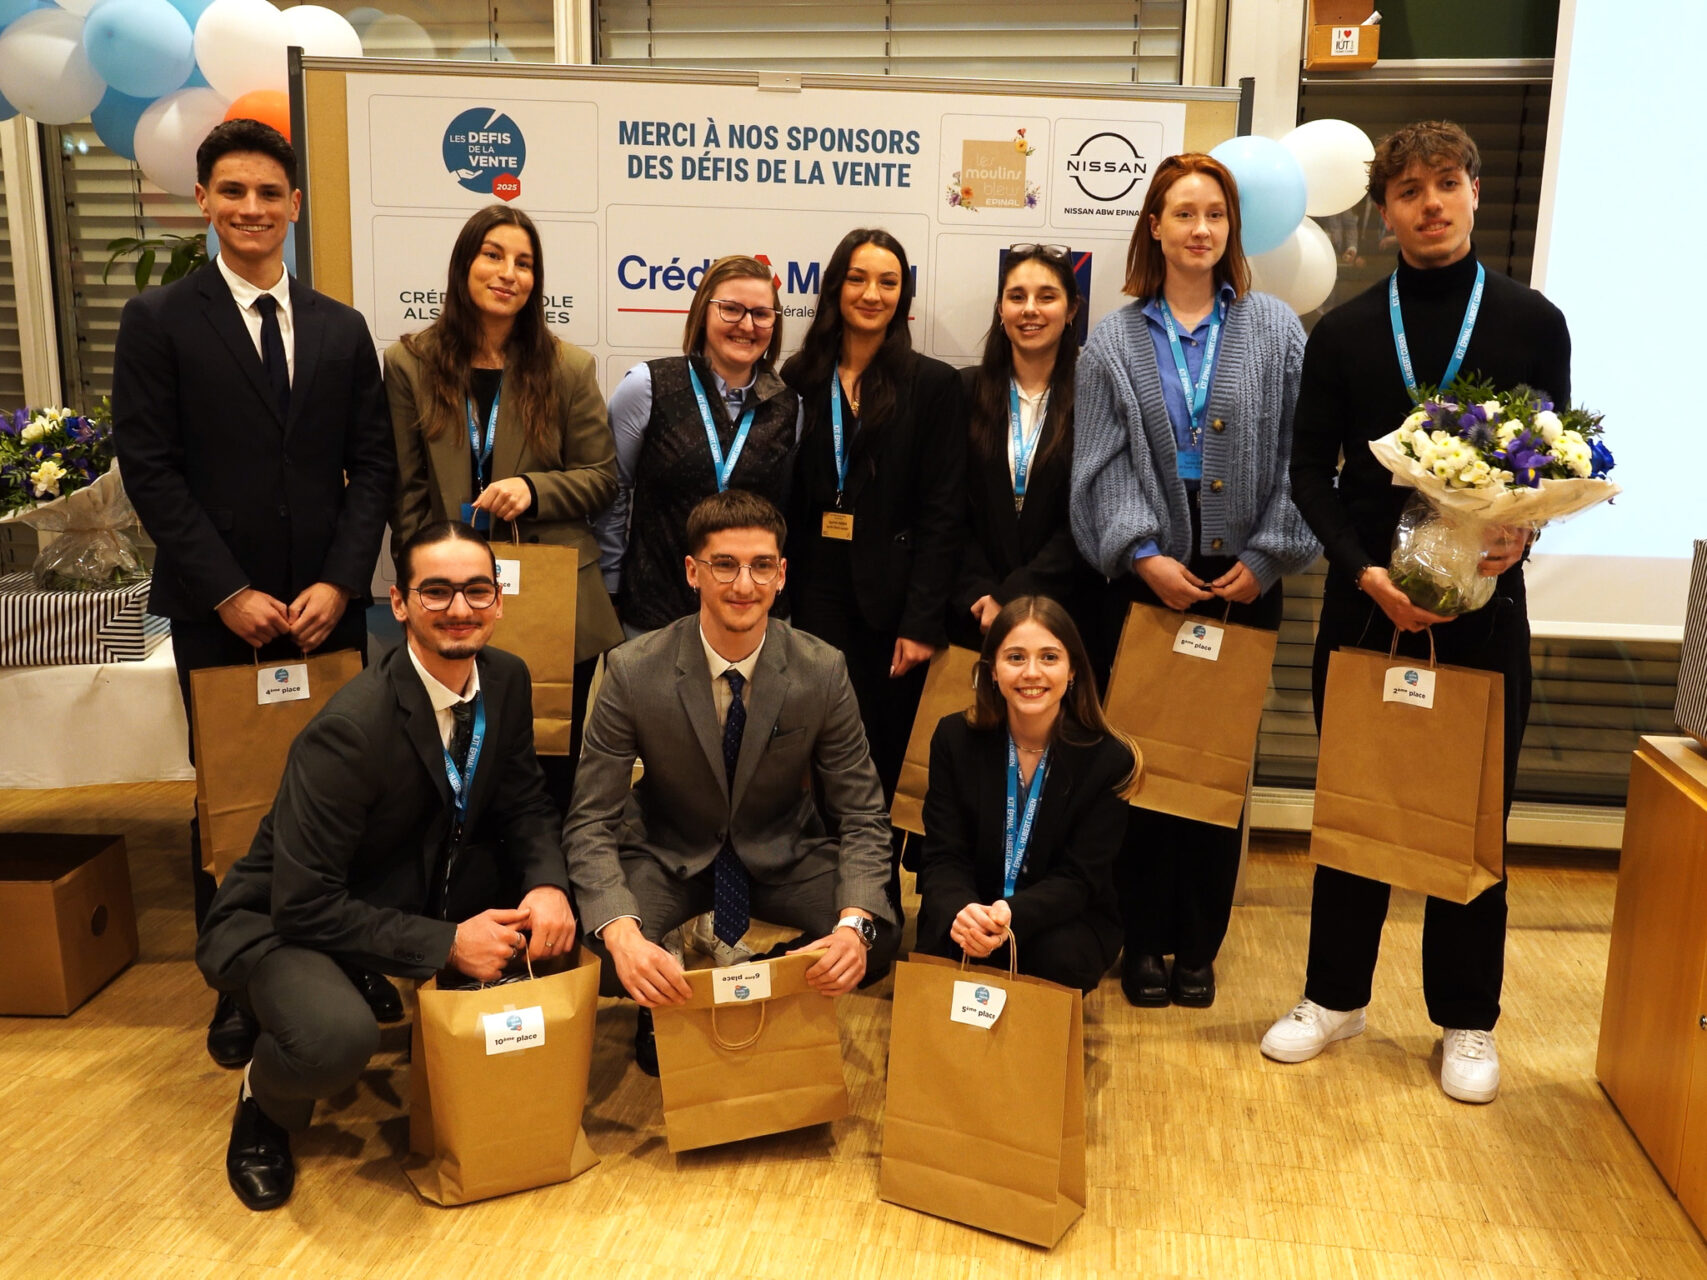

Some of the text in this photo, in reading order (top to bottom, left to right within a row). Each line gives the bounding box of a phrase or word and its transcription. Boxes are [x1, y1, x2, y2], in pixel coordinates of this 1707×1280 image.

[619, 117, 920, 154] MERCI À NOS SPONSORS
[469, 156, 517, 168] VENTE
[628, 151, 911, 187] DES DÉFIS DE LA VENTE
[966, 166, 1022, 180] moulins
[1067, 160, 1146, 174] NISSAN
[618, 255, 710, 291] Créd
[1006, 808, 1015, 829] ÉPINAL
[1025, 797, 1037, 820] CURIEN
[1019, 819, 1032, 844] HUBERT
[1012, 846, 1024, 868] ÉPINAL
[516, 1034, 537, 1043] place
